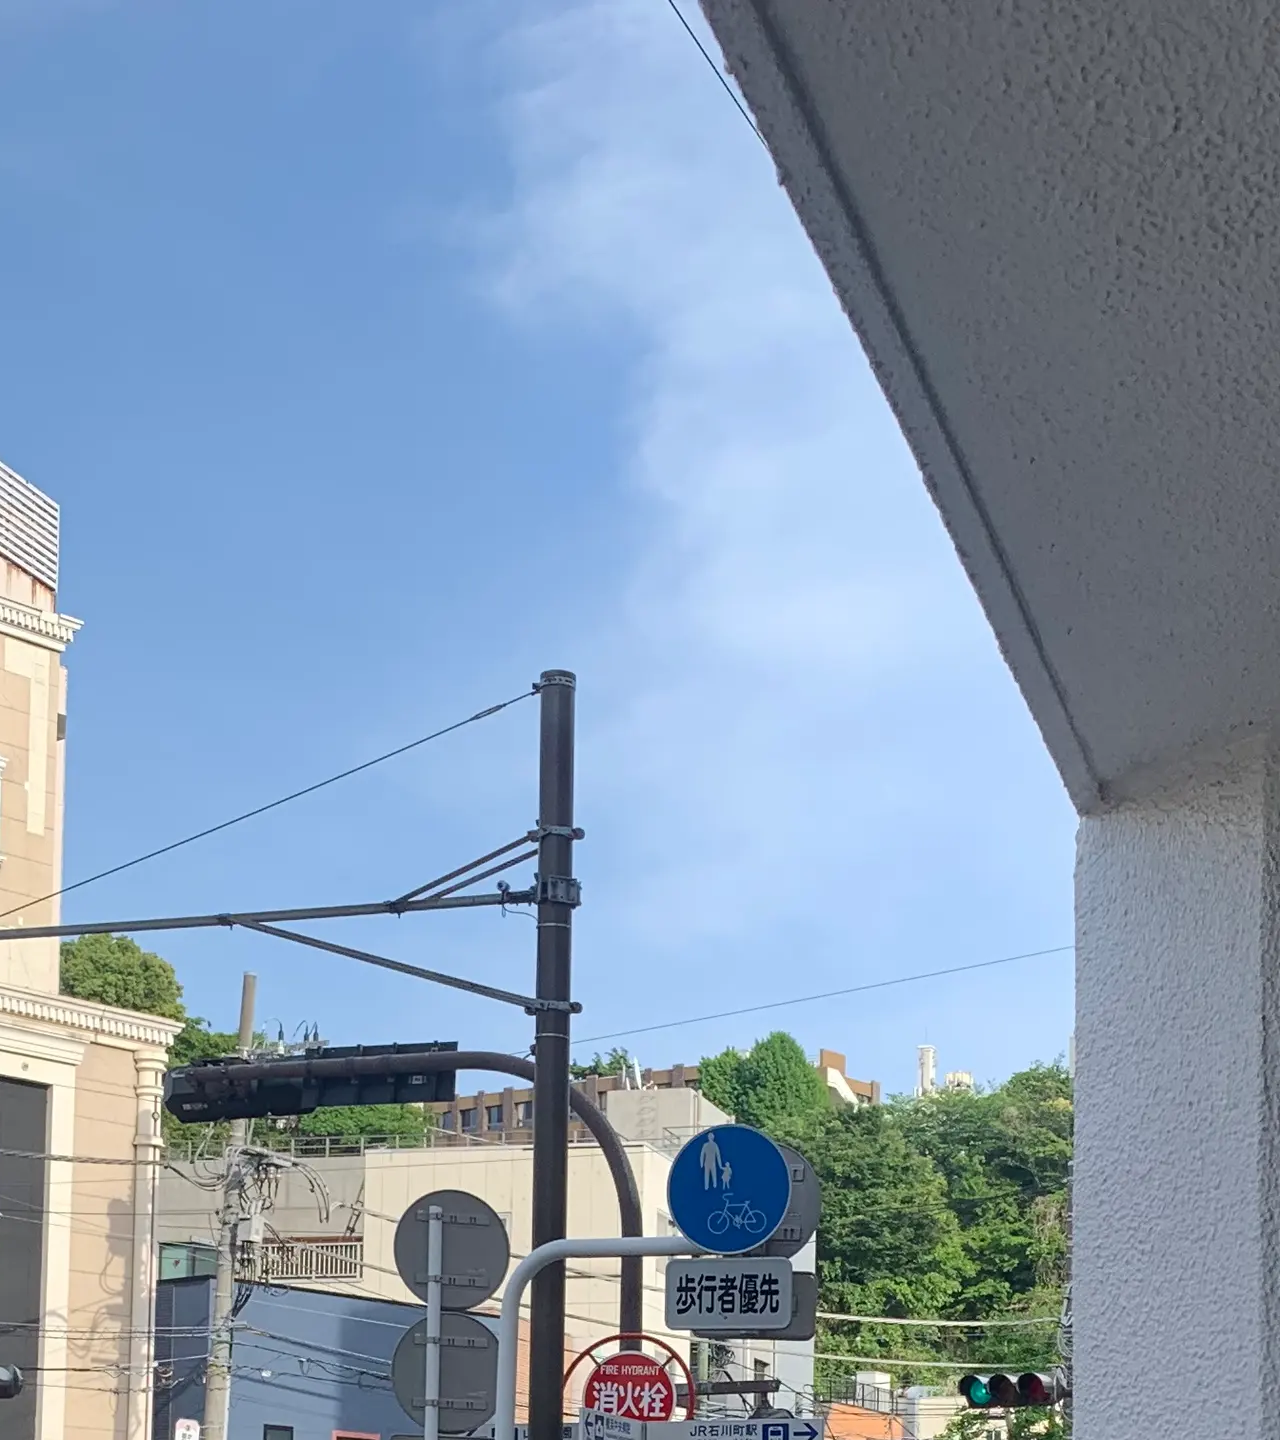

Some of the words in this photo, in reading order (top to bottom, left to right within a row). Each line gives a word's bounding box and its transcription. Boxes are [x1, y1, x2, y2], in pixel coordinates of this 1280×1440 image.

[676, 1273, 780, 1315] 歩行者優先
[600, 1365, 619, 1375] FIRE
[620, 1365, 660, 1376] HYDRANT
[592, 1381, 667, 1418] 消火栓
[689, 1424, 758, 1437] JR石川町駅
